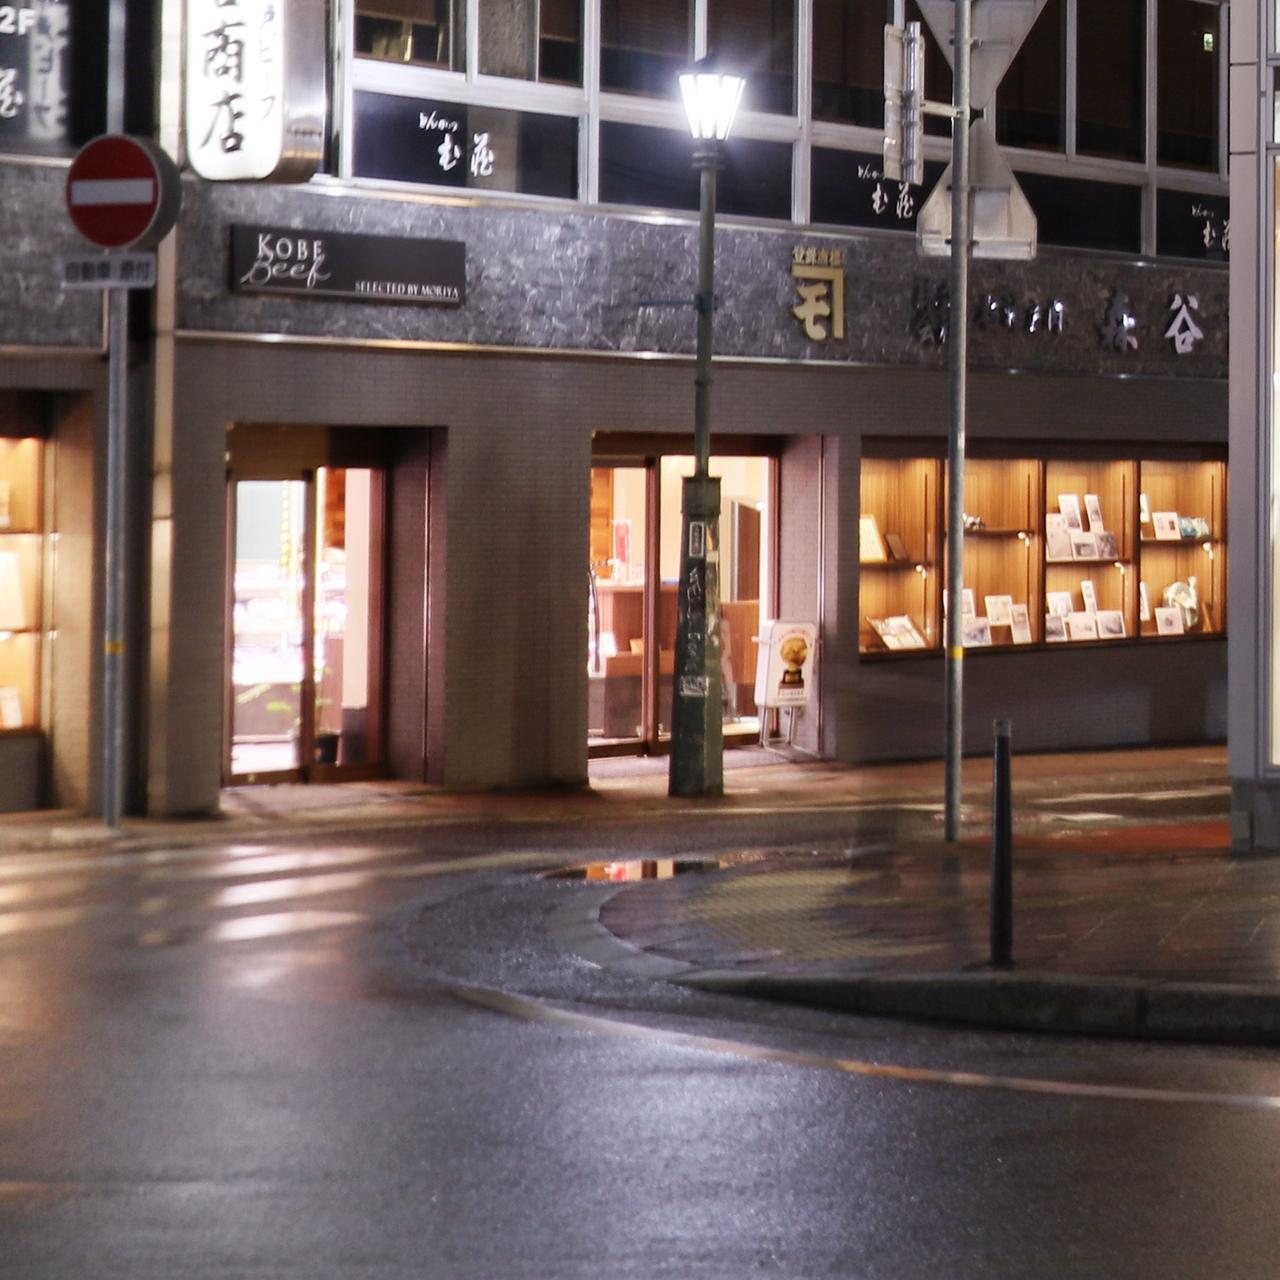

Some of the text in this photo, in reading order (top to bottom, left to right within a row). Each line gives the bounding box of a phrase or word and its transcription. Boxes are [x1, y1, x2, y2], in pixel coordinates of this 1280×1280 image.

[257, 233, 323, 259] KOBE
[240, 244, 331, 288] Beef
[355, 281, 459, 298] SELECTED BY MORIYA
